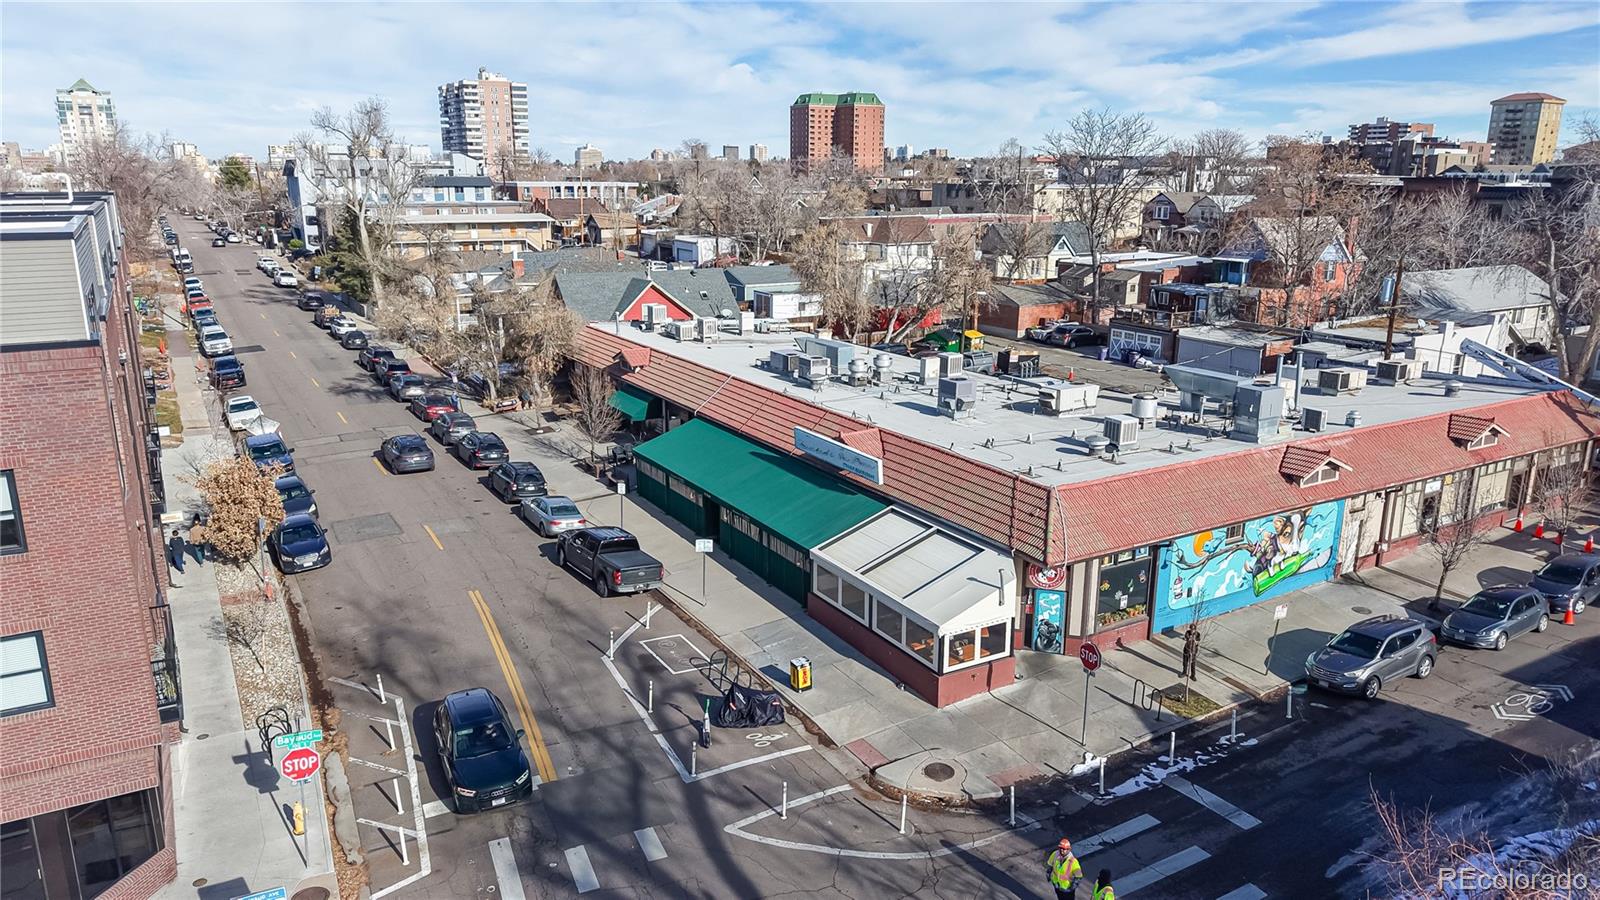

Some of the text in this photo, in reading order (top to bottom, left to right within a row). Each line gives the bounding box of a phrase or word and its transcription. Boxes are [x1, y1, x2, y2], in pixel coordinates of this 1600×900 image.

[1081, 648, 1098, 664] STOP
[277, 732, 313, 745] Bayaud
[284, 756, 317, 772] STOP
